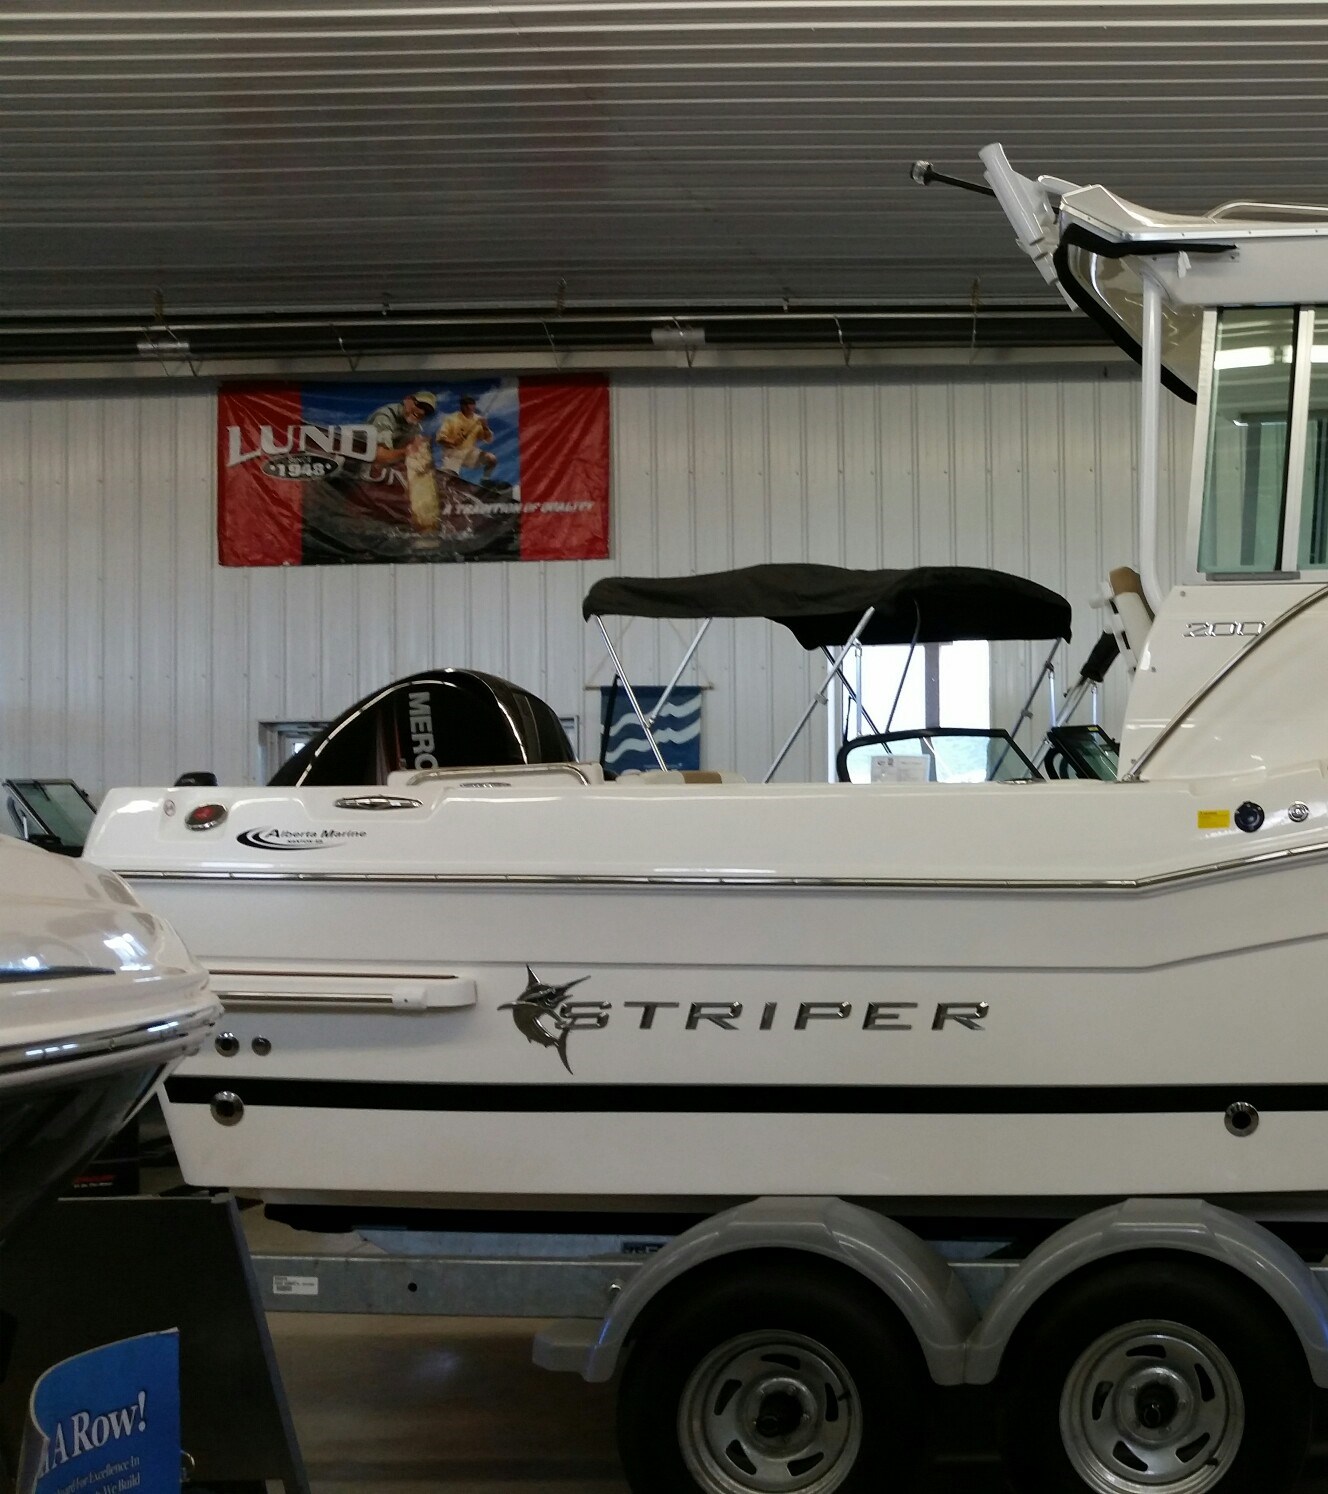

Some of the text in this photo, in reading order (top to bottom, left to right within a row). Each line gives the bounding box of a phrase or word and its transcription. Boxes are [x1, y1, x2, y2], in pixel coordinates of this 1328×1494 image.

[226, 423, 378, 468] LUND
[1182, 621, 1266, 637] 200
[265, 829, 367, 838] Alberta Marine
[556, 1000, 989, 1031] STRIPER
